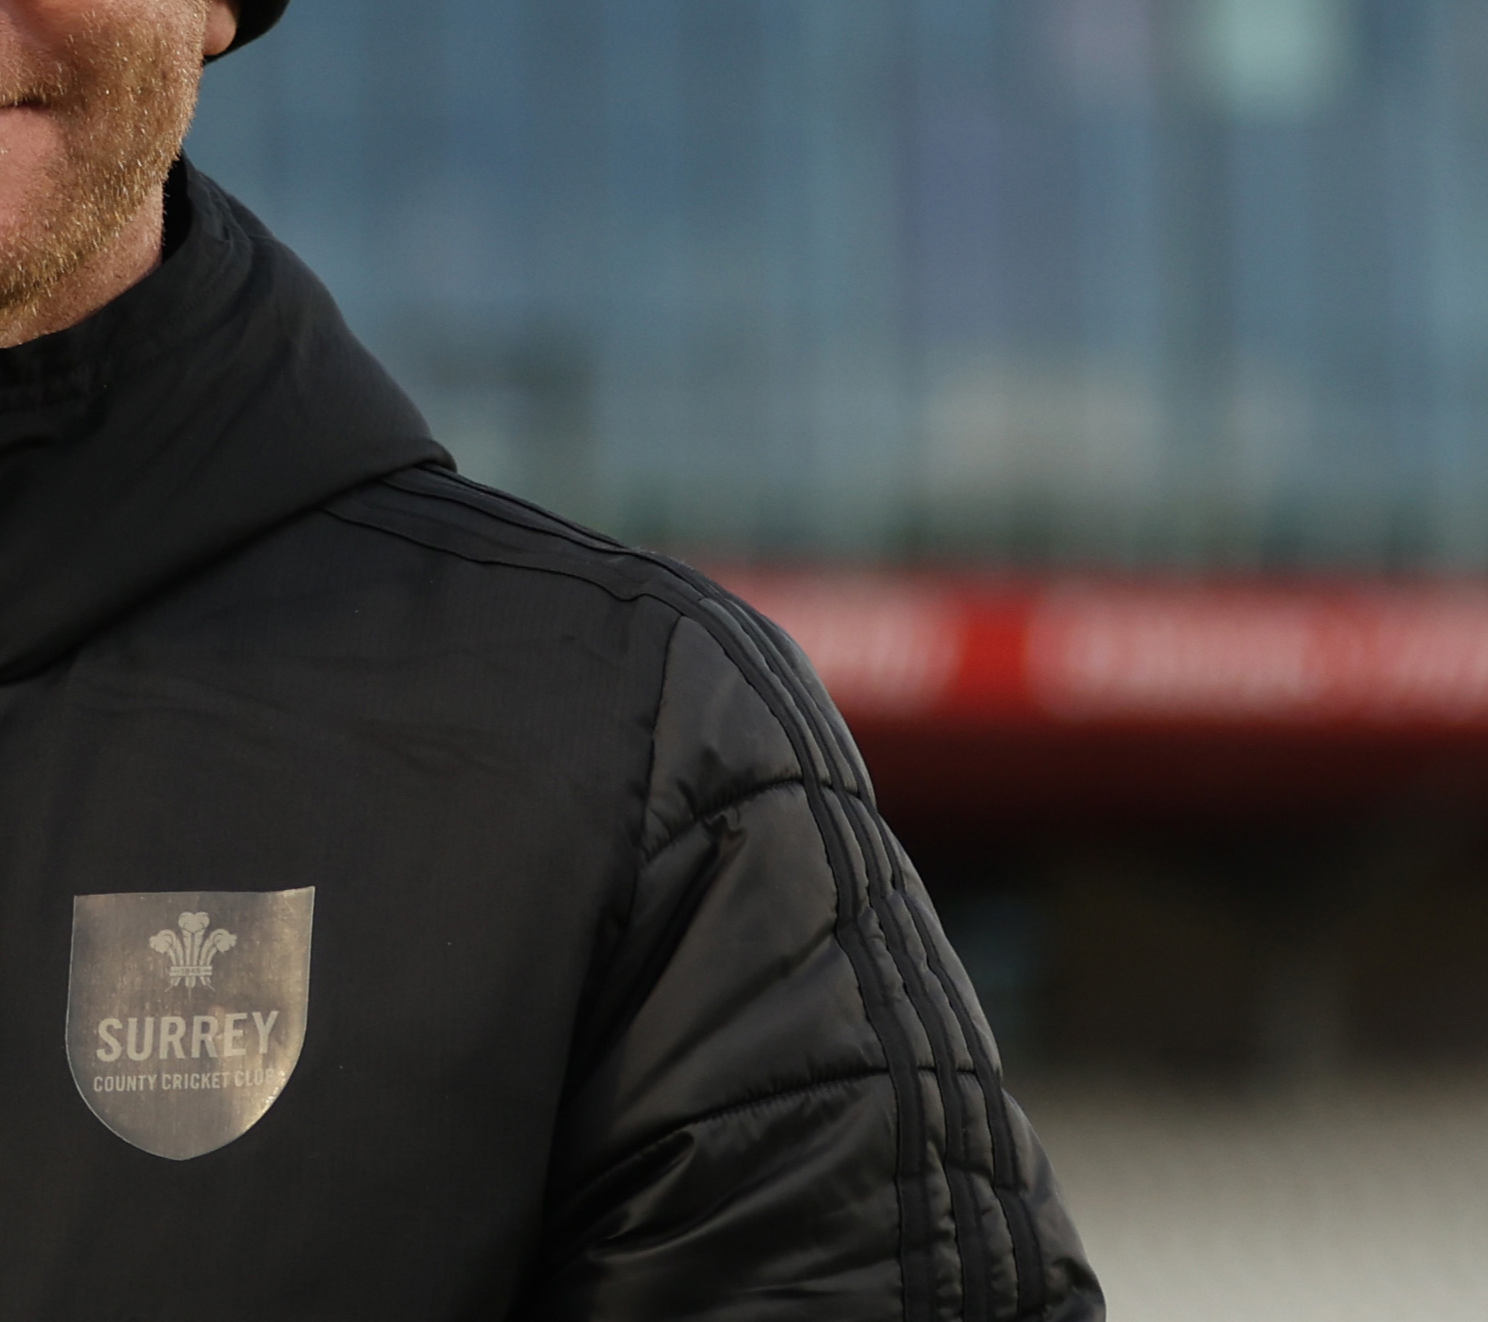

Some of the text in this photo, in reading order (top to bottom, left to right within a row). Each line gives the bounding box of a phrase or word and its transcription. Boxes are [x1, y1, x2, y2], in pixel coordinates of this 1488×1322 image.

[95, 1010, 279, 1063] SURREY
[93, 1068, 275, 1093] COUNTY CRICKET CLUB
